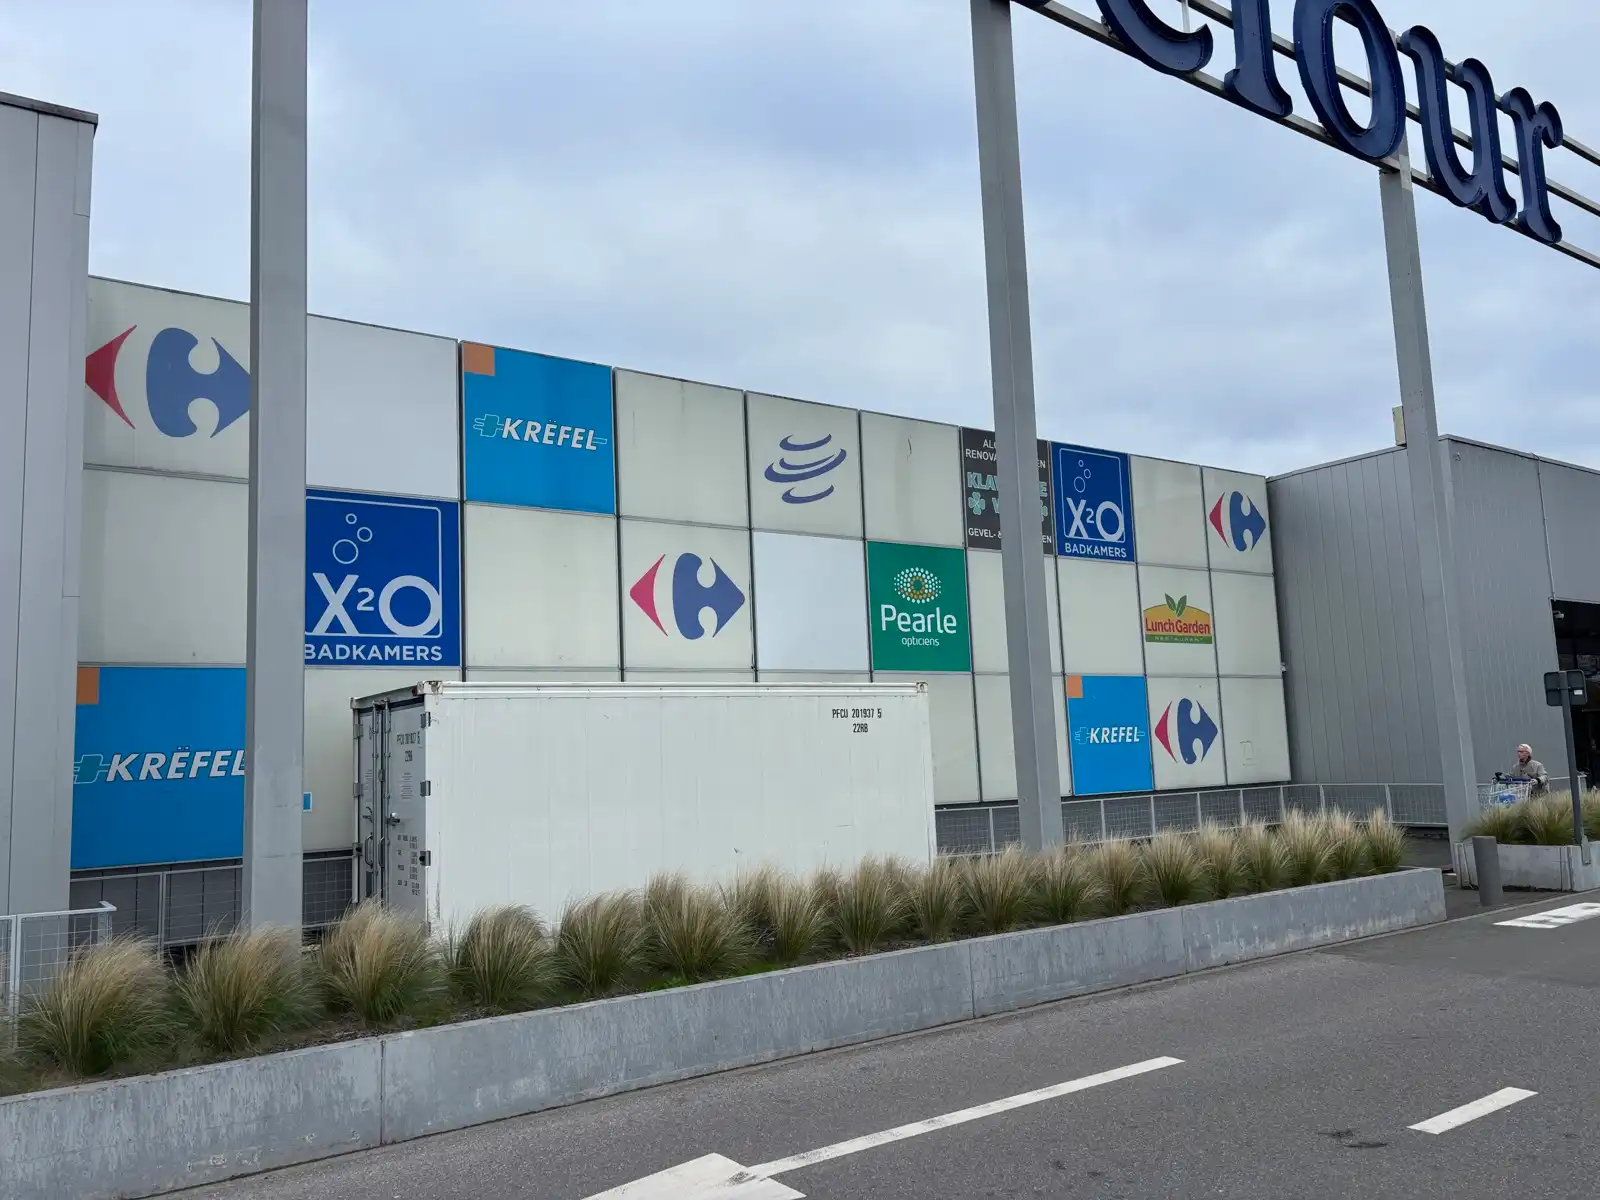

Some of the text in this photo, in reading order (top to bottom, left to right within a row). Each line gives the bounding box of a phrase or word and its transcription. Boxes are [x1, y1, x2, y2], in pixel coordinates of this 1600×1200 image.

[502, 418, 597, 451] KRËFEL
[968, 527, 997, 538] GEVEL-
[1064, 542, 1127, 558] BADKAMERS
[880, 604, 957, 634] Pearle
[1145, 617, 1211, 635] Lunch Garden
[901, 636, 940, 648] opticiens
[304, 643, 443, 661] BADKAMERS
[832, 708, 849, 719] PFCU
[852, 708, 875, 719] 201937
[106, 746, 245, 782] KRËFEL
